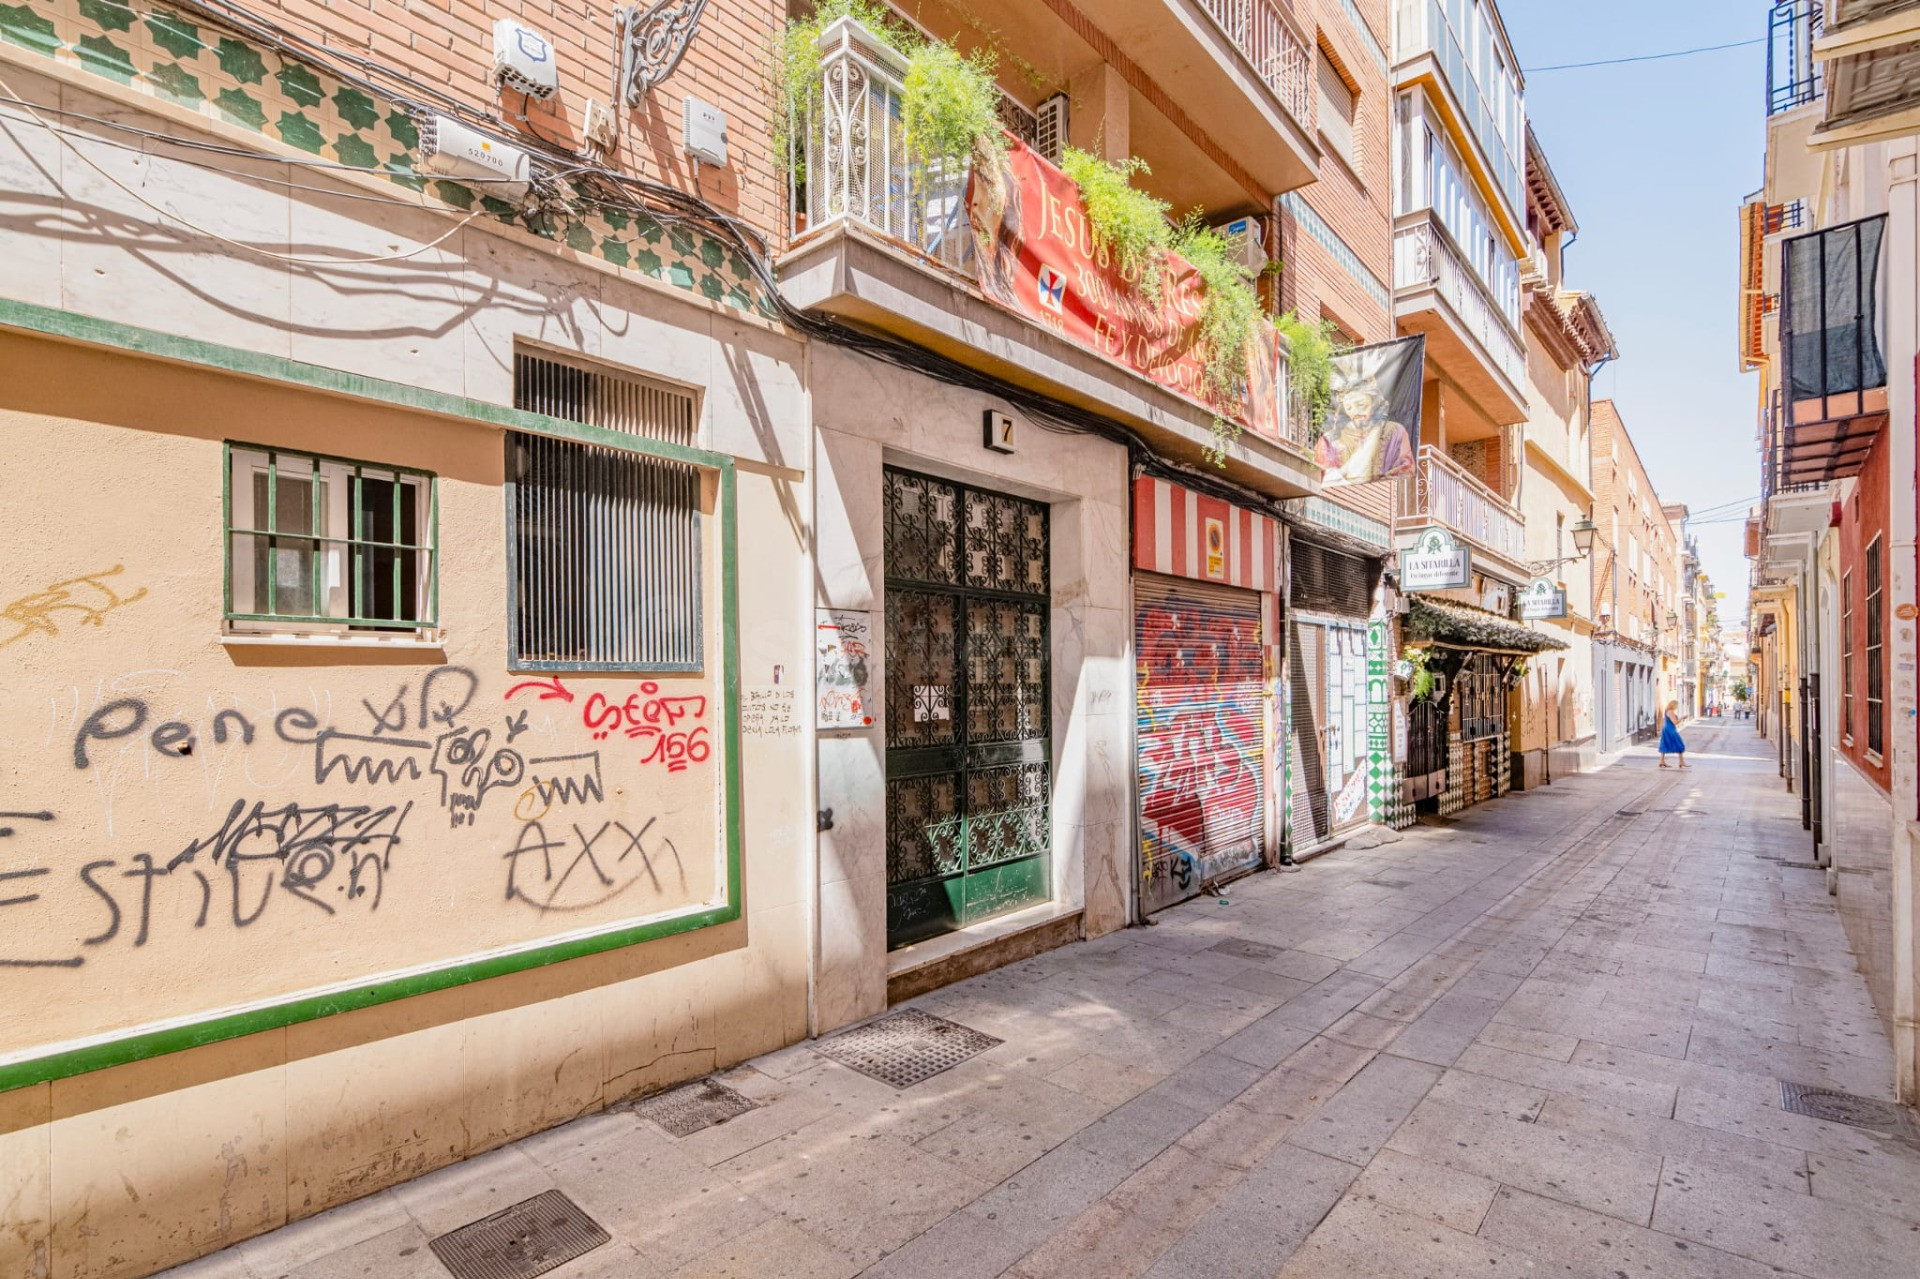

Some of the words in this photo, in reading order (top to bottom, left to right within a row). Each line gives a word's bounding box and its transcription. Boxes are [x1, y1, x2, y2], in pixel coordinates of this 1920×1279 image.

[468, 148, 504, 167] 520700
[1074, 262, 1110, 310] 300
[1168, 318, 1187, 352] DE
[1093, 312, 1117, 355] FE
[1121, 330, 1133, 362] Y
[1002, 418, 1012, 442] 7
[1409, 561, 1419, 570] LA
[1421, 558, 1461, 570] SITARILLA
